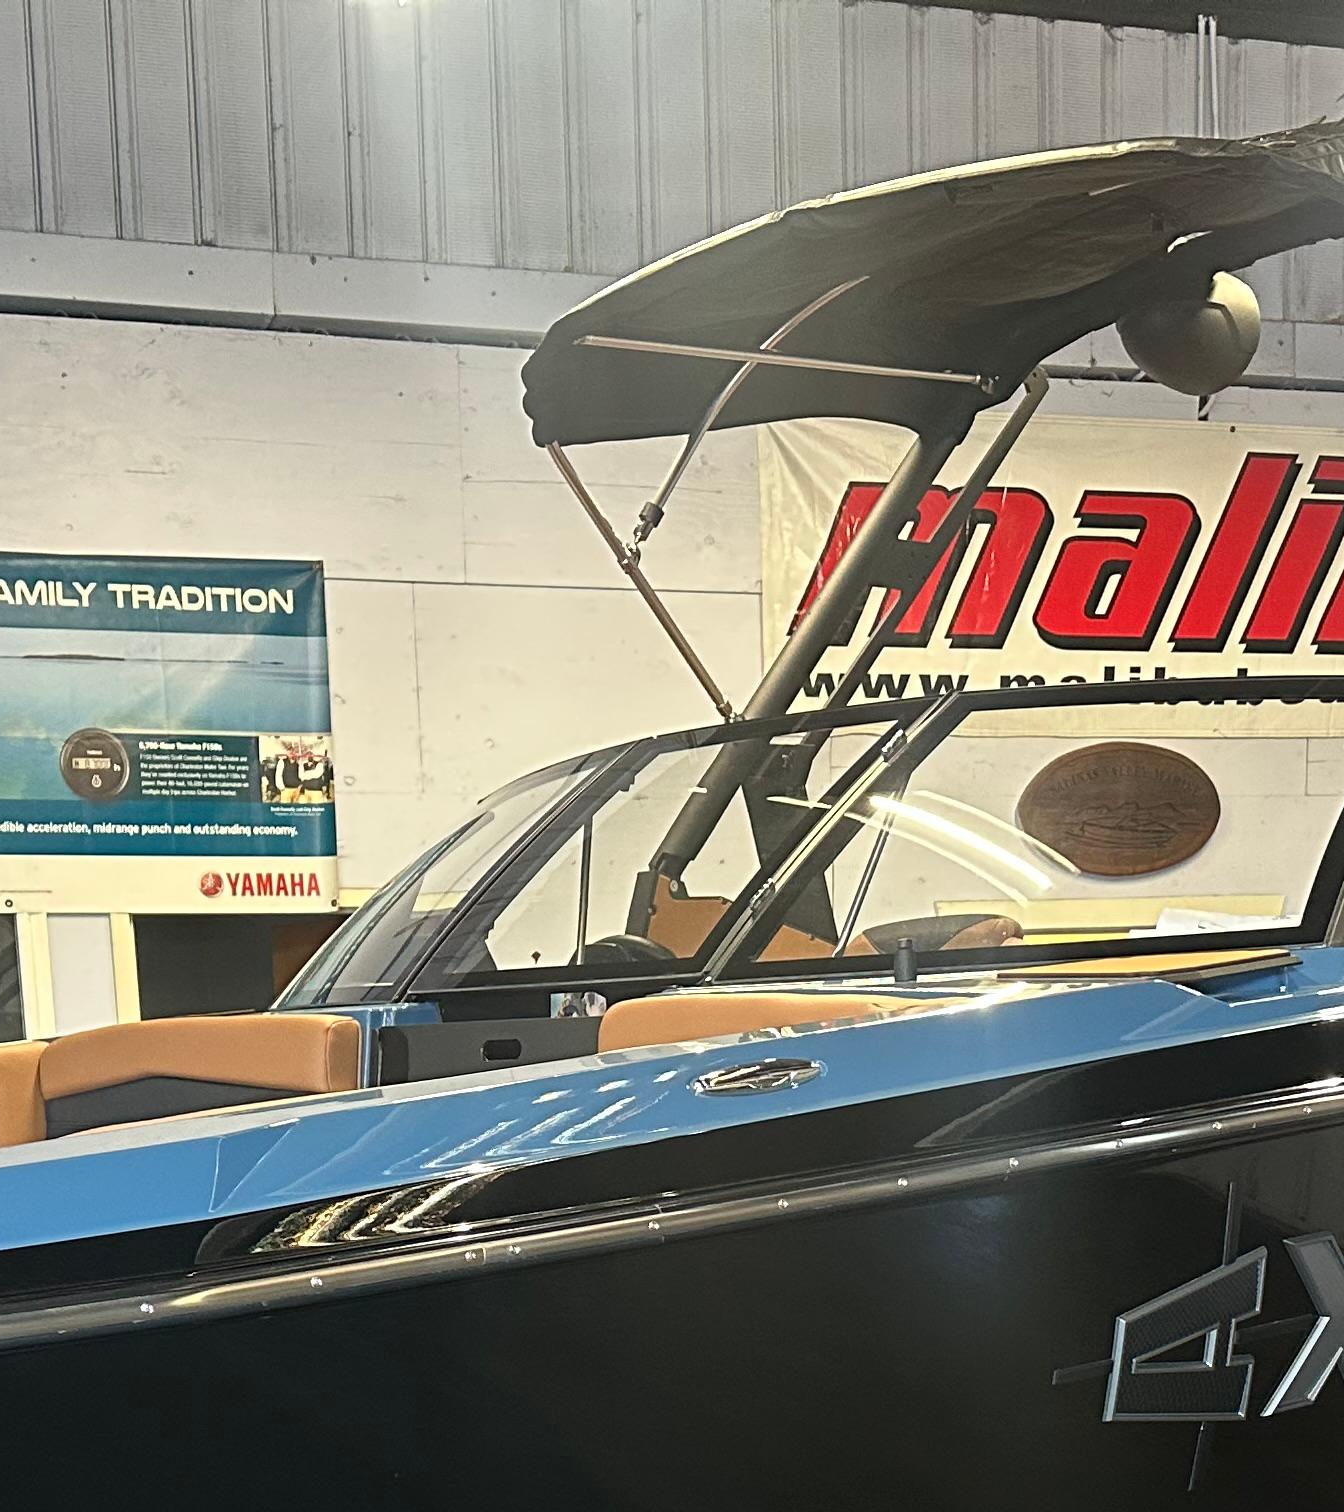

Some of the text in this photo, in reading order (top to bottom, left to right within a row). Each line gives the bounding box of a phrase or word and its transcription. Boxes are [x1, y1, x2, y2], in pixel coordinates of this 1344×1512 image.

[107, 583, 294, 615] TRADITION
[26, 822, 91, 835] acceleration,
[93, 822, 139, 836] midrange
[141, 823, 172, 836] punch
[174, 823, 192, 835] and
[193, 824, 252, 837] outstanding
[253, 824, 298, 838] economy.
[226, 872, 321, 897] YAMAHA
